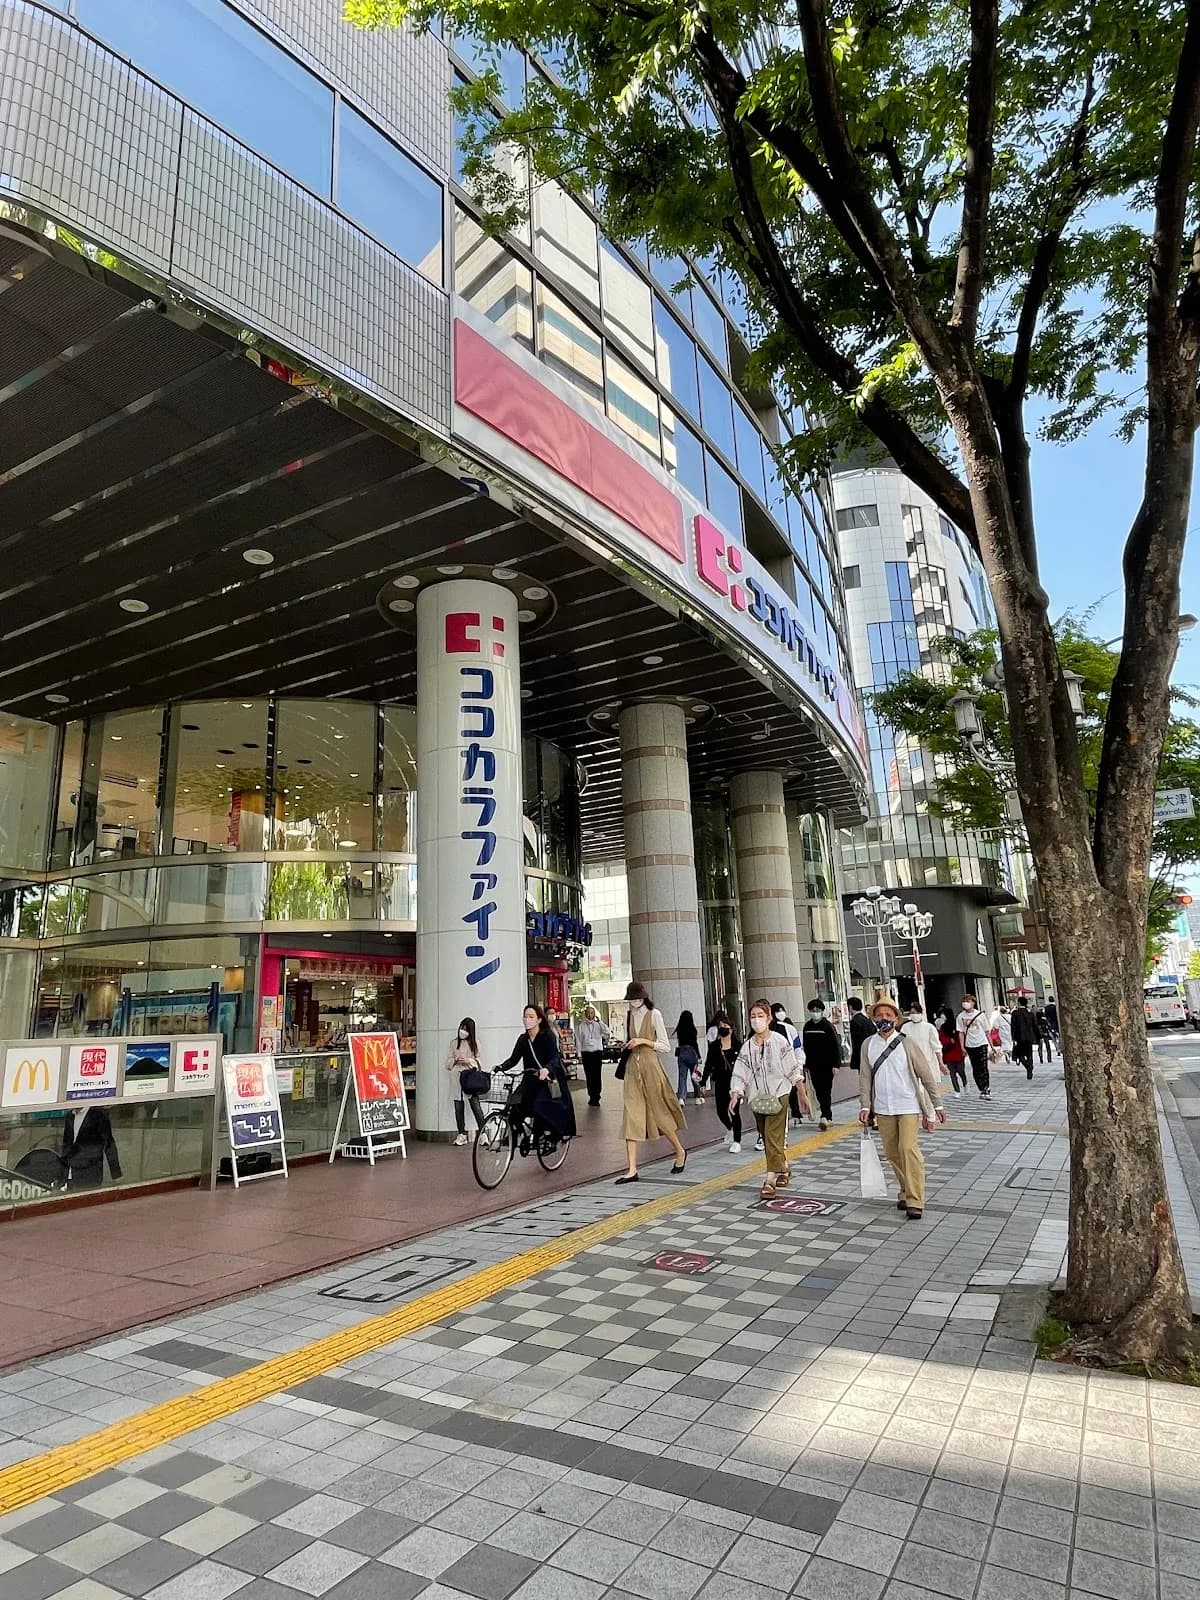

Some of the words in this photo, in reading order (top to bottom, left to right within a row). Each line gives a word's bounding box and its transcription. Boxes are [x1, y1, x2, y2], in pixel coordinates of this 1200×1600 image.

[1156, 793, 1188, 808] 大津
[460, 667, 500, 985] ココカラファイン
[82, 1051, 105, 1062] 現代
[82, 1063, 105, 1074] 仏壇
[259, 1115, 273, 1128] B1
